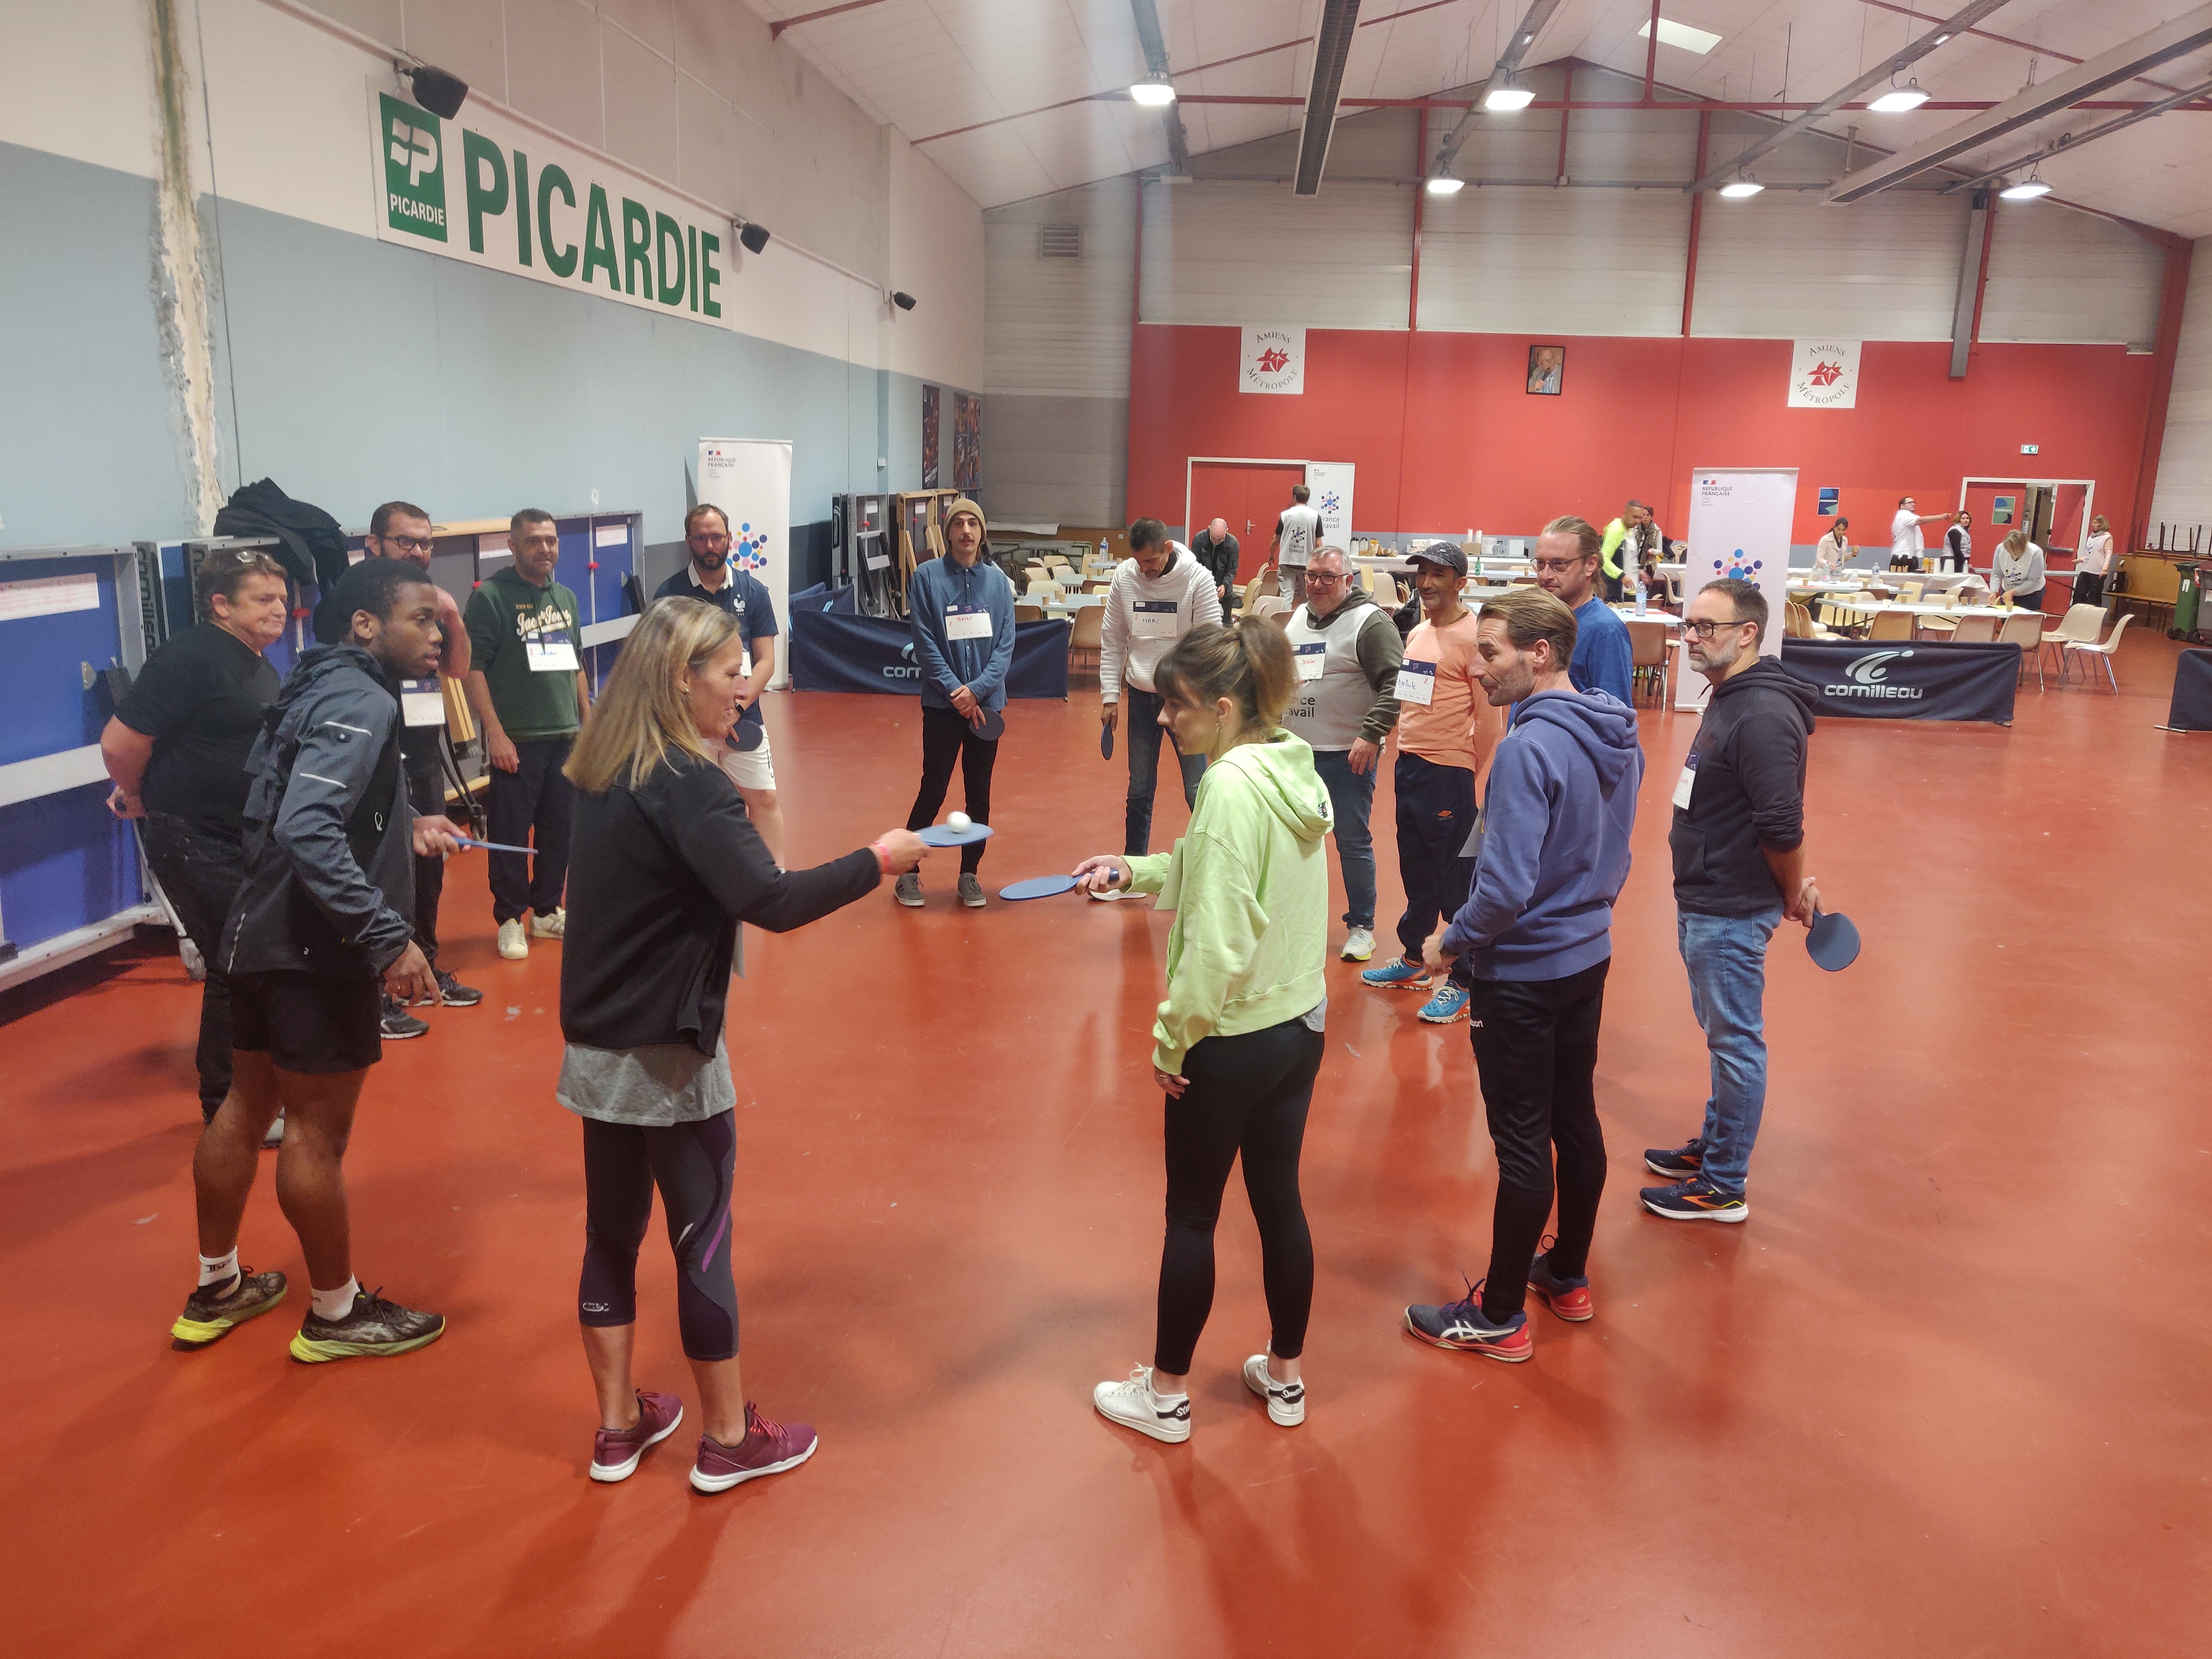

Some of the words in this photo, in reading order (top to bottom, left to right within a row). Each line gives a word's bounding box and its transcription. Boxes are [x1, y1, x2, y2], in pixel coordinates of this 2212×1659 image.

[390, 192, 445, 226] PICARDIE
[463, 128, 721, 318] PICARDIE
[1257, 332, 1291, 344] AMIENS
[1810, 345, 1846, 356] AMIENS
[1247, 368, 1298, 389] MÉTROPOLE
[1797, 382, 1851, 404] MÉTROPOLE
[1824, 684, 1923, 699] cornilleau
